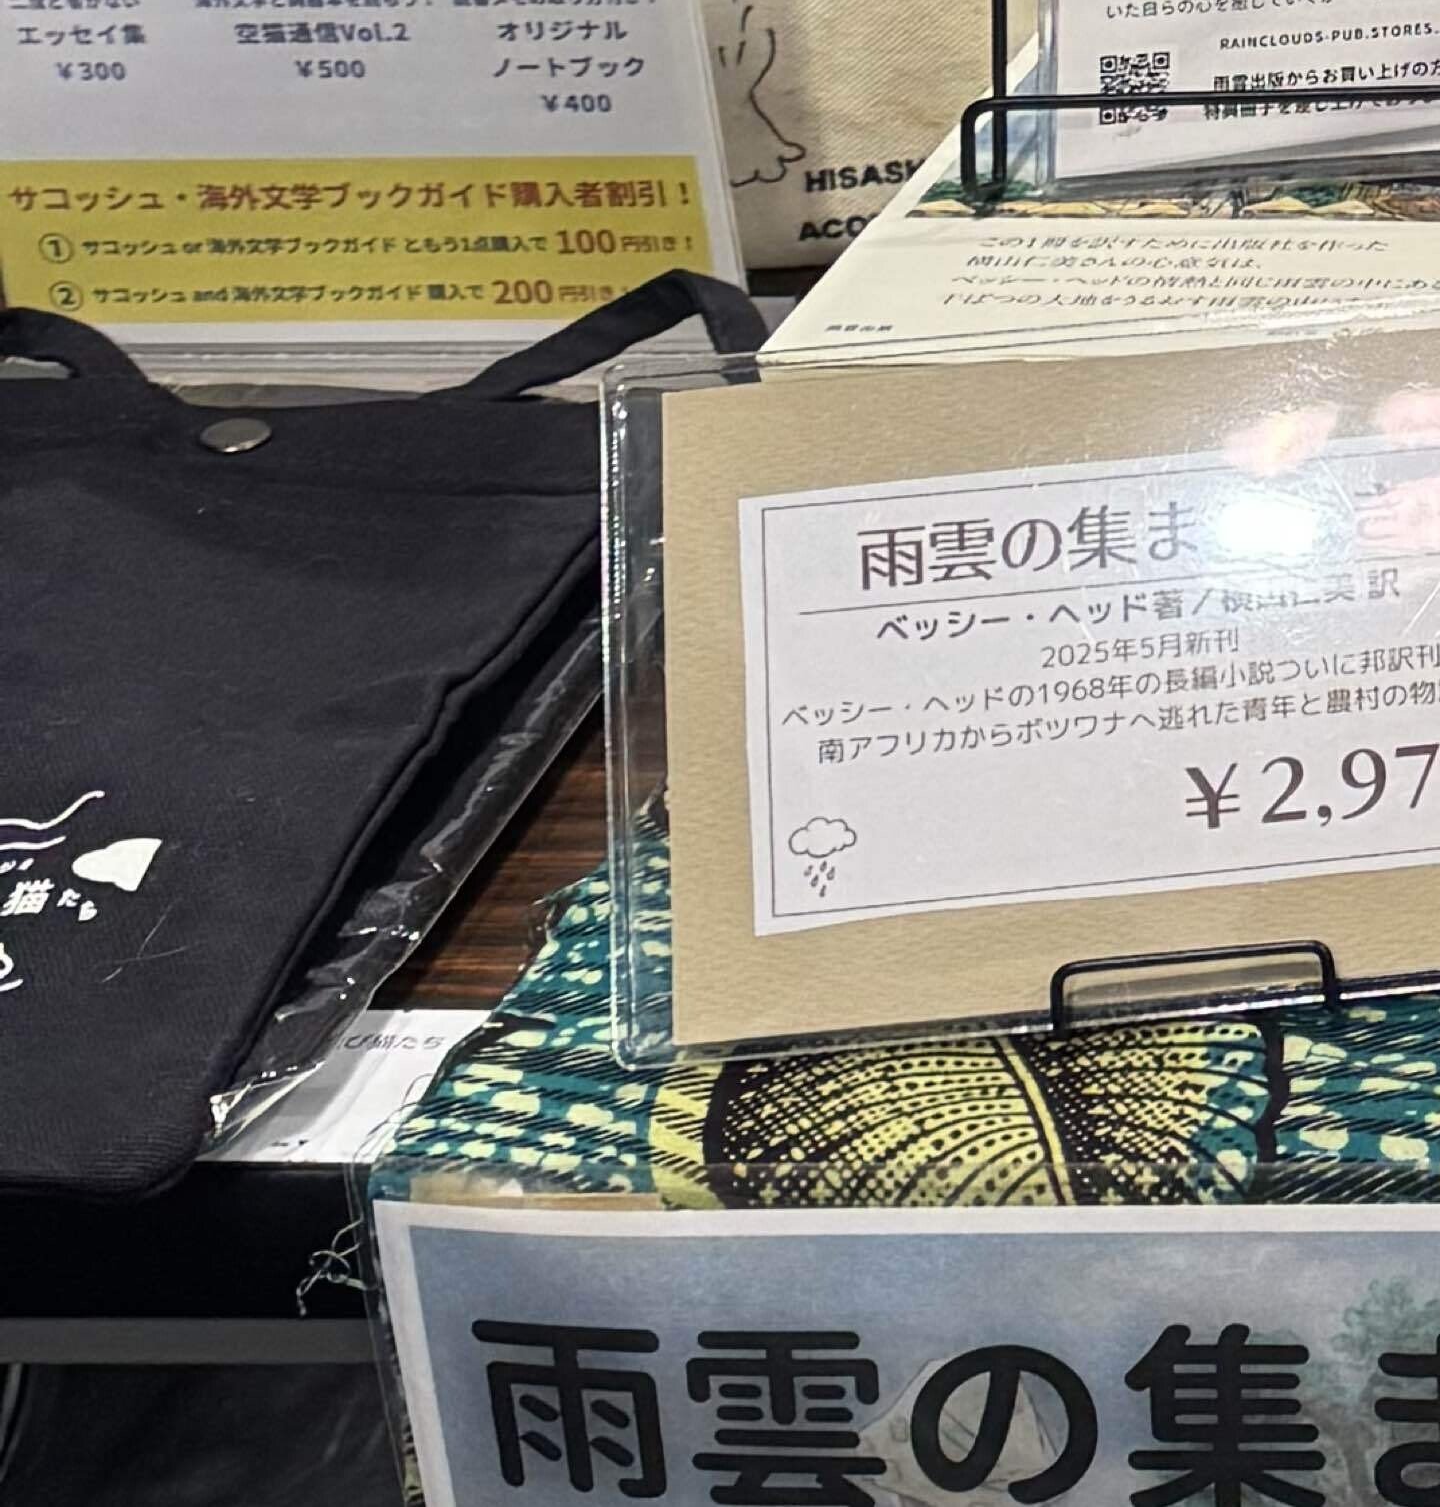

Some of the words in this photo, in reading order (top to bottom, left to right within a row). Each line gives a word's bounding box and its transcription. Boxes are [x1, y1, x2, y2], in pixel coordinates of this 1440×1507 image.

[17, 24, 147, 45] エッセイ集
[497, 20, 628, 42] オリジナル
[58, 62, 126, 82] ¥300
[294, 60, 366, 80] ¥500
[492, 56, 645, 77] ノートブック
[541, 94, 612, 113] ¥400
[82, 240, 175, 256] サコッシュ
[182, 241, 201, 255] or
[556, 229, 616, 255] 100
[93, 287, 187, 304] サコッシュ
[193, 286, 228, 303] and
[491, 279, 553, 305] 200
[1041, 628, 1240, 671] 2025年5月新刊
